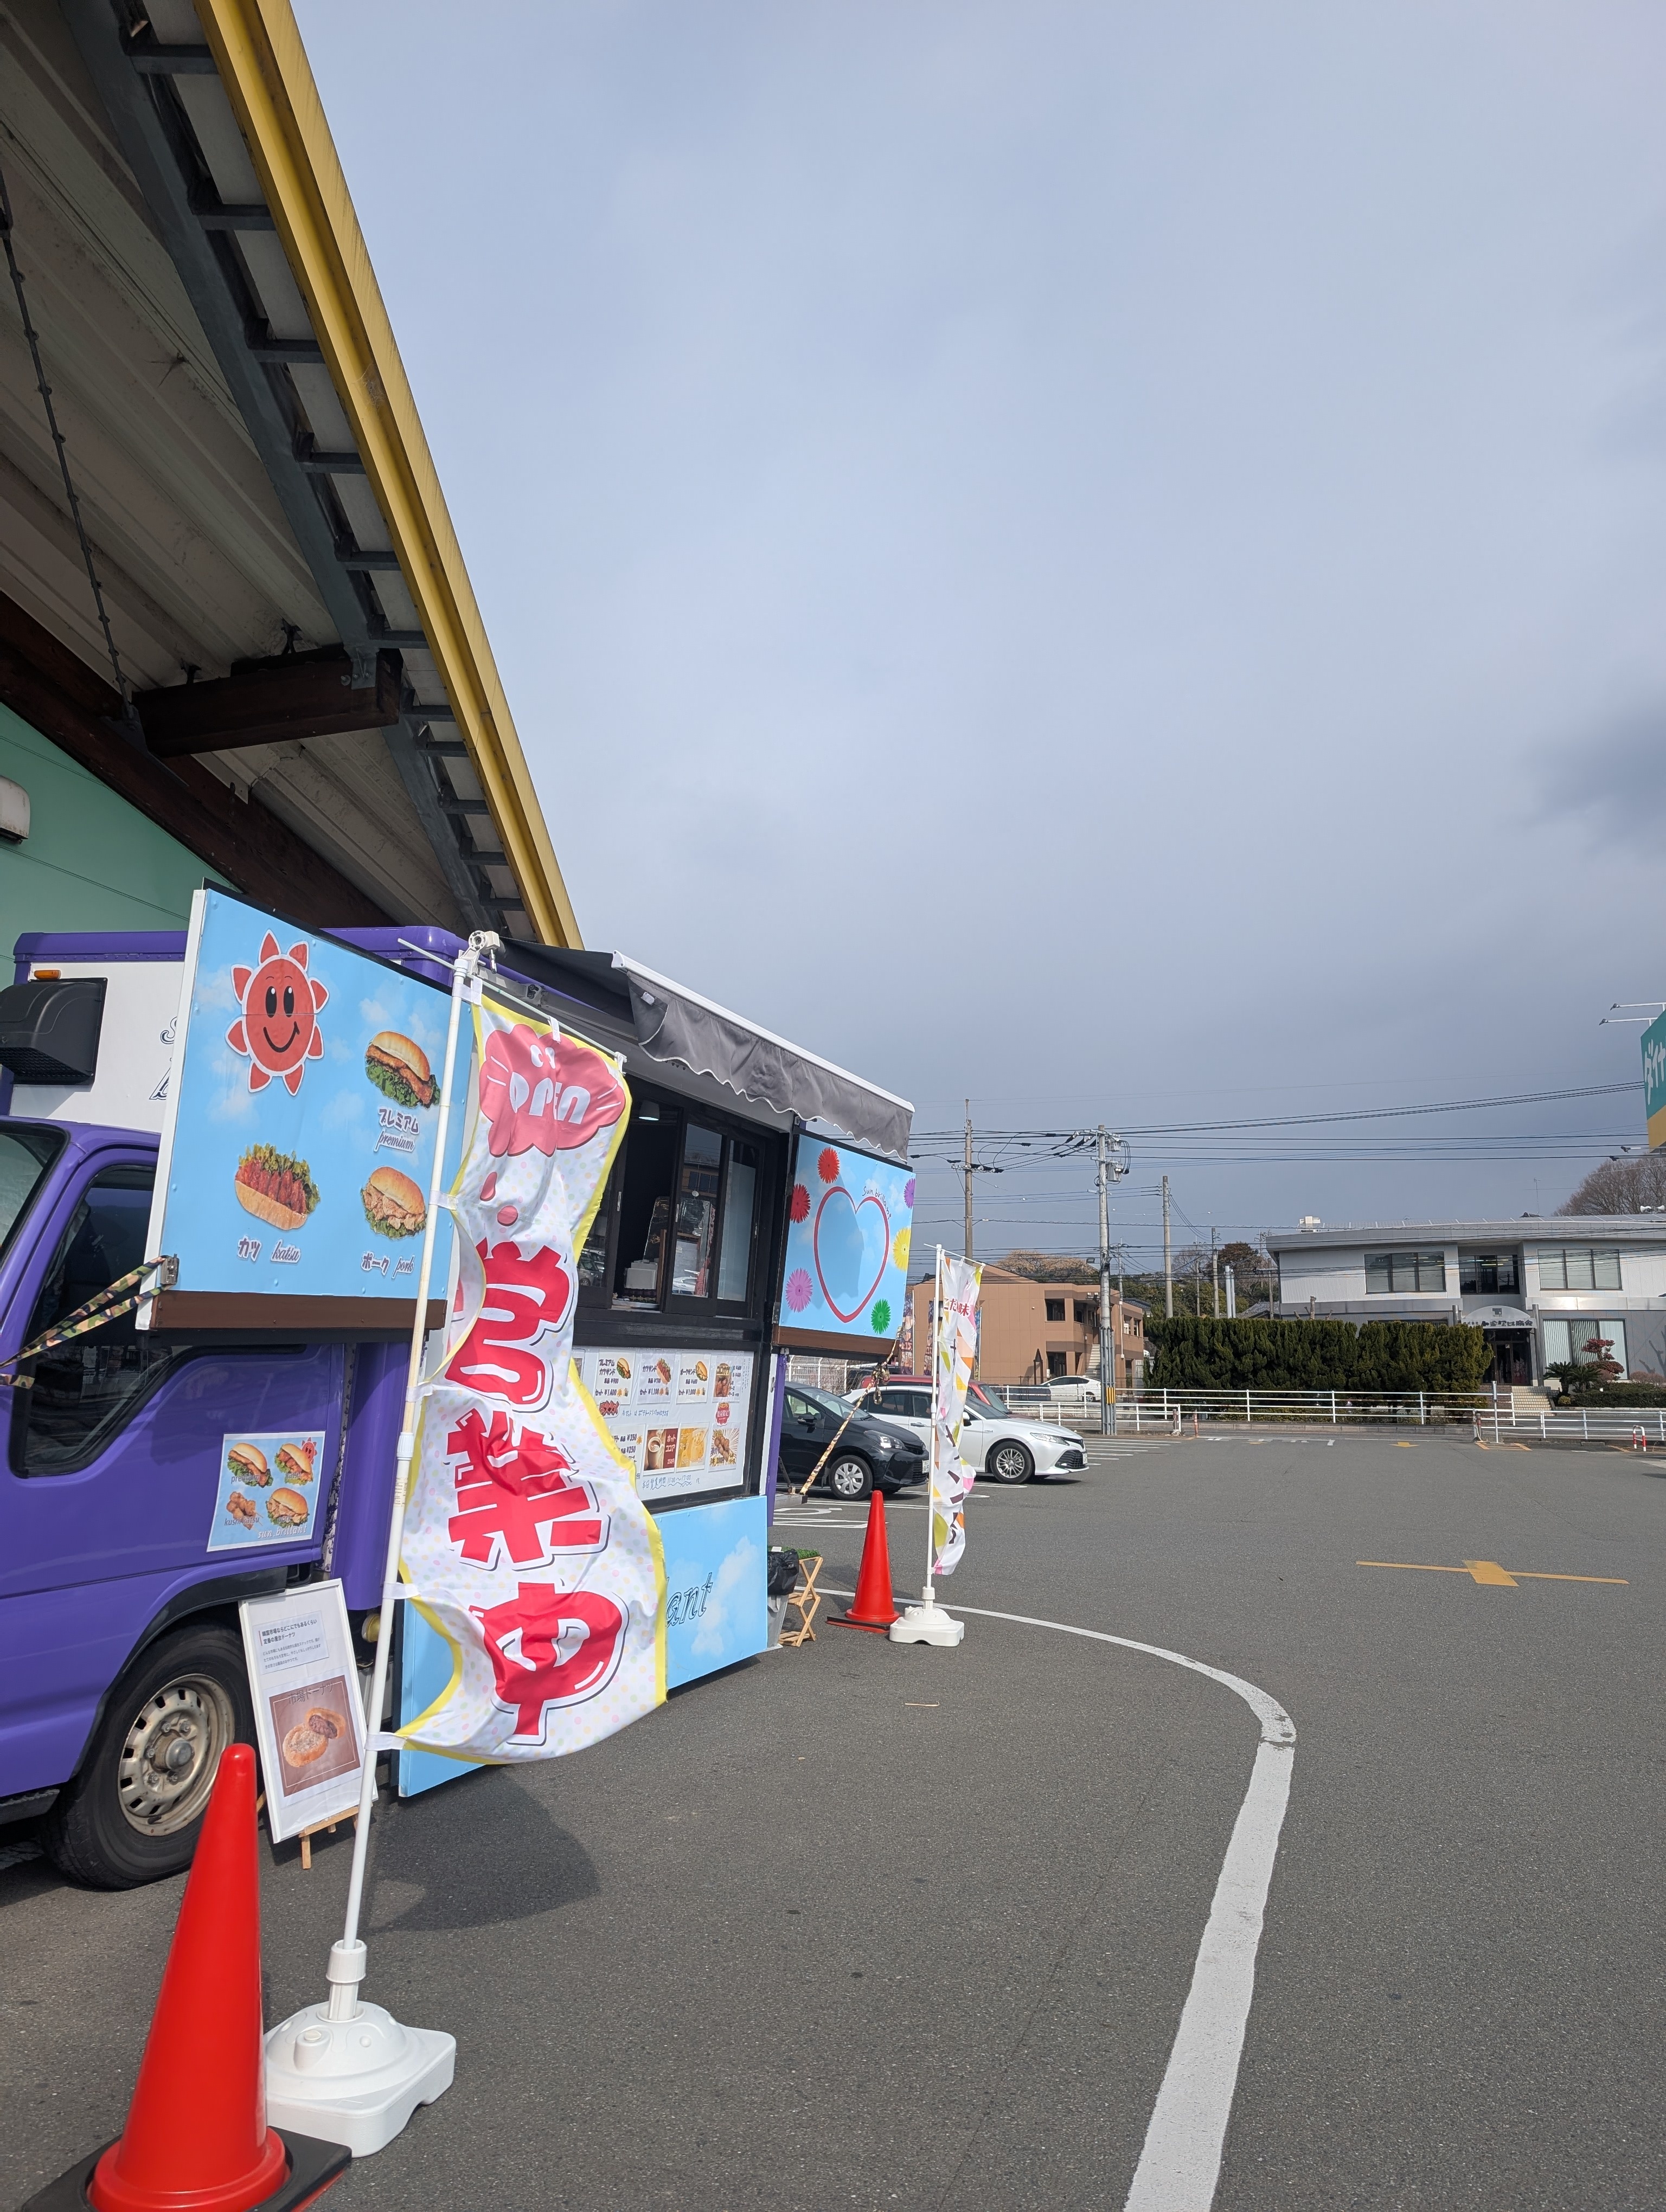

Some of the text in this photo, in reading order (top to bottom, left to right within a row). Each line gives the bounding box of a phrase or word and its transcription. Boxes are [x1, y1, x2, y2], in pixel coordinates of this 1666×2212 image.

[380, 1109, 419, 1133] プレミアム
[375, 1131, 414, 1150] premium
[239, 1238, 299, 1261] カツ katsu
[362, 1253, 414, 1278] ポーク pork
[598, 1359, 615, 1367] プレミアム
[626, 1433, 637, 1442] ¥350
[667, 1434, 676, 1442] ホット
[626, 1445, 636, 1454] ¥250
[665, 1444, 676, 1452] ココア
[230, 1473, 260, 1484] premium
[666, 1572, 714, 1628] ant
[288, 1682, 333, 1705] 市場ドーナツ
